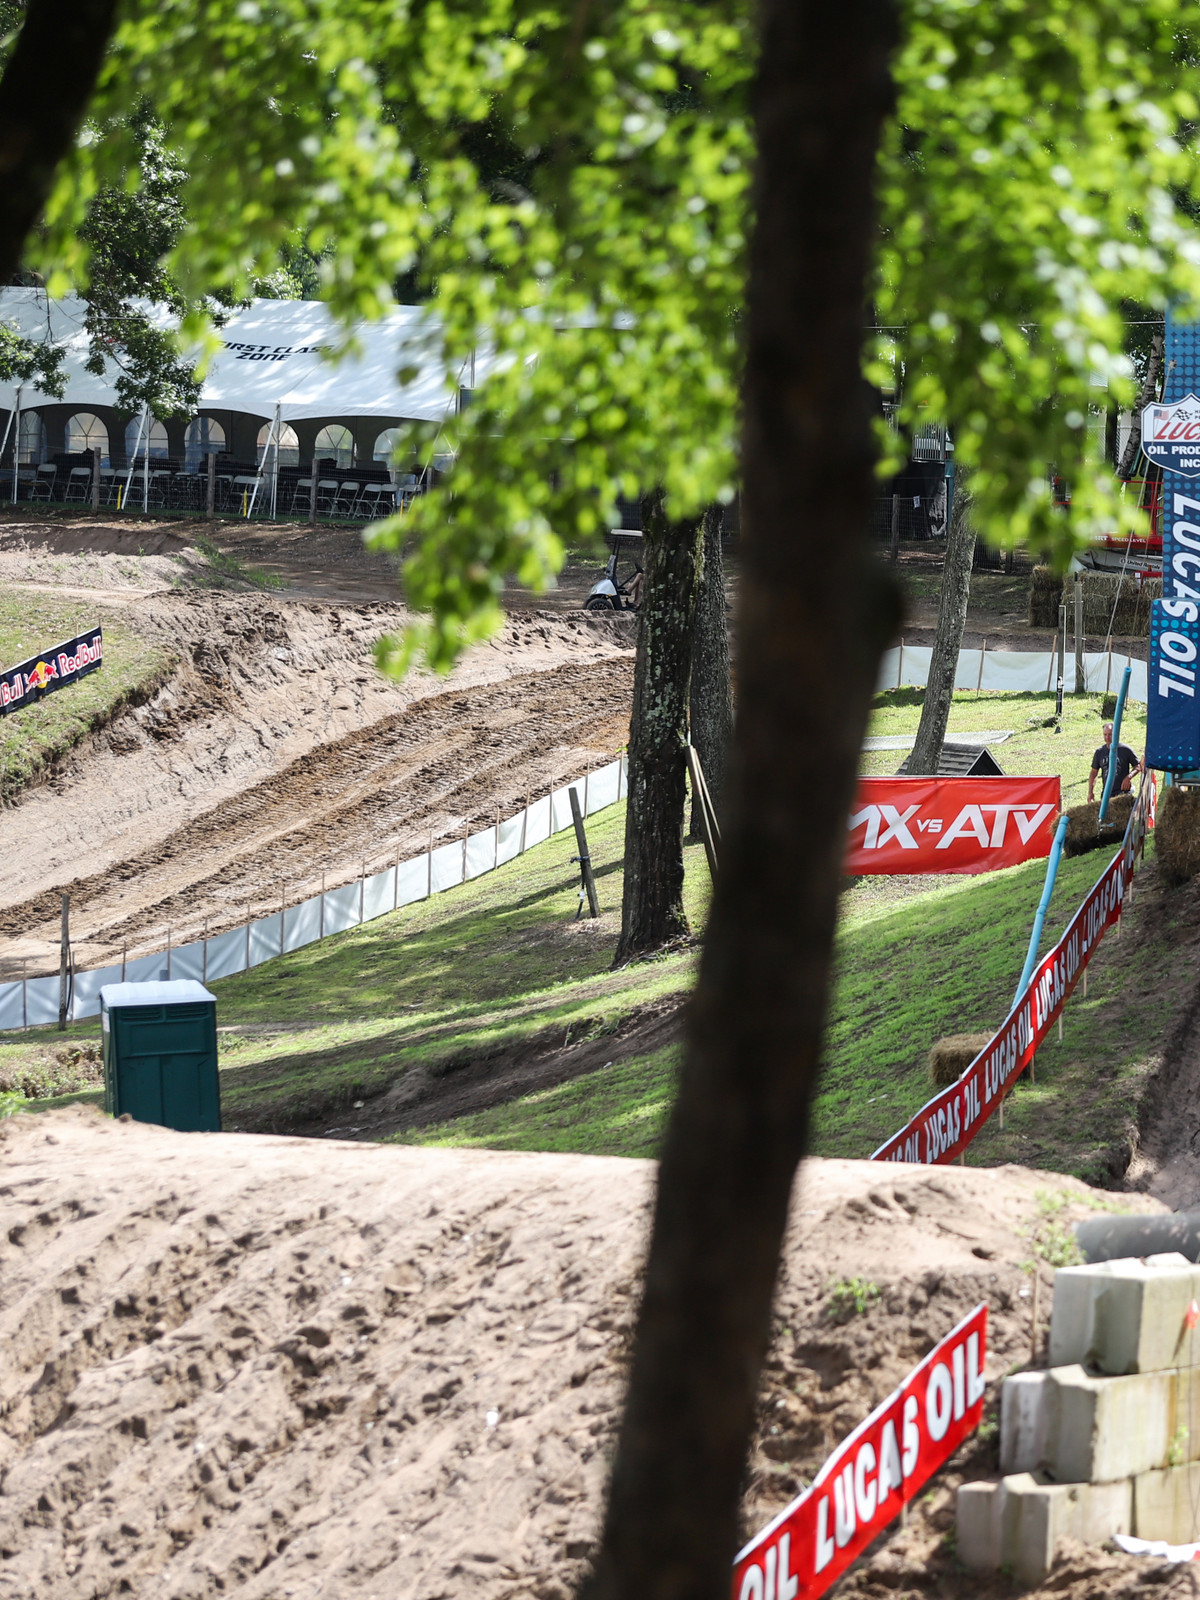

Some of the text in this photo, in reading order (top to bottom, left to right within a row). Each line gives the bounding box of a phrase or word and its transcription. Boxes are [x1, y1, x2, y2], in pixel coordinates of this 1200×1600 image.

[235, 351, 292, 361] ZONE
[1147, 446, 1168, 455] OIL
[1158, 631, 1197, 699] OIL
[0, 673, 24, 706] Bull
[935, 803, 1056, 849] ATV
[923, 1095, 961, 1164] LUCAS
[985, 1023, 1017, 1105] LUCAS
[1018, 1000, 1035, 1057] OIL
[1035, 951, 1066, 1031] LUCAS
[1066, 928, 1079, 983] OIL
[815, 1394, 919, 1575] LUCAS
[926, 1330, 986, 1442] OIL
